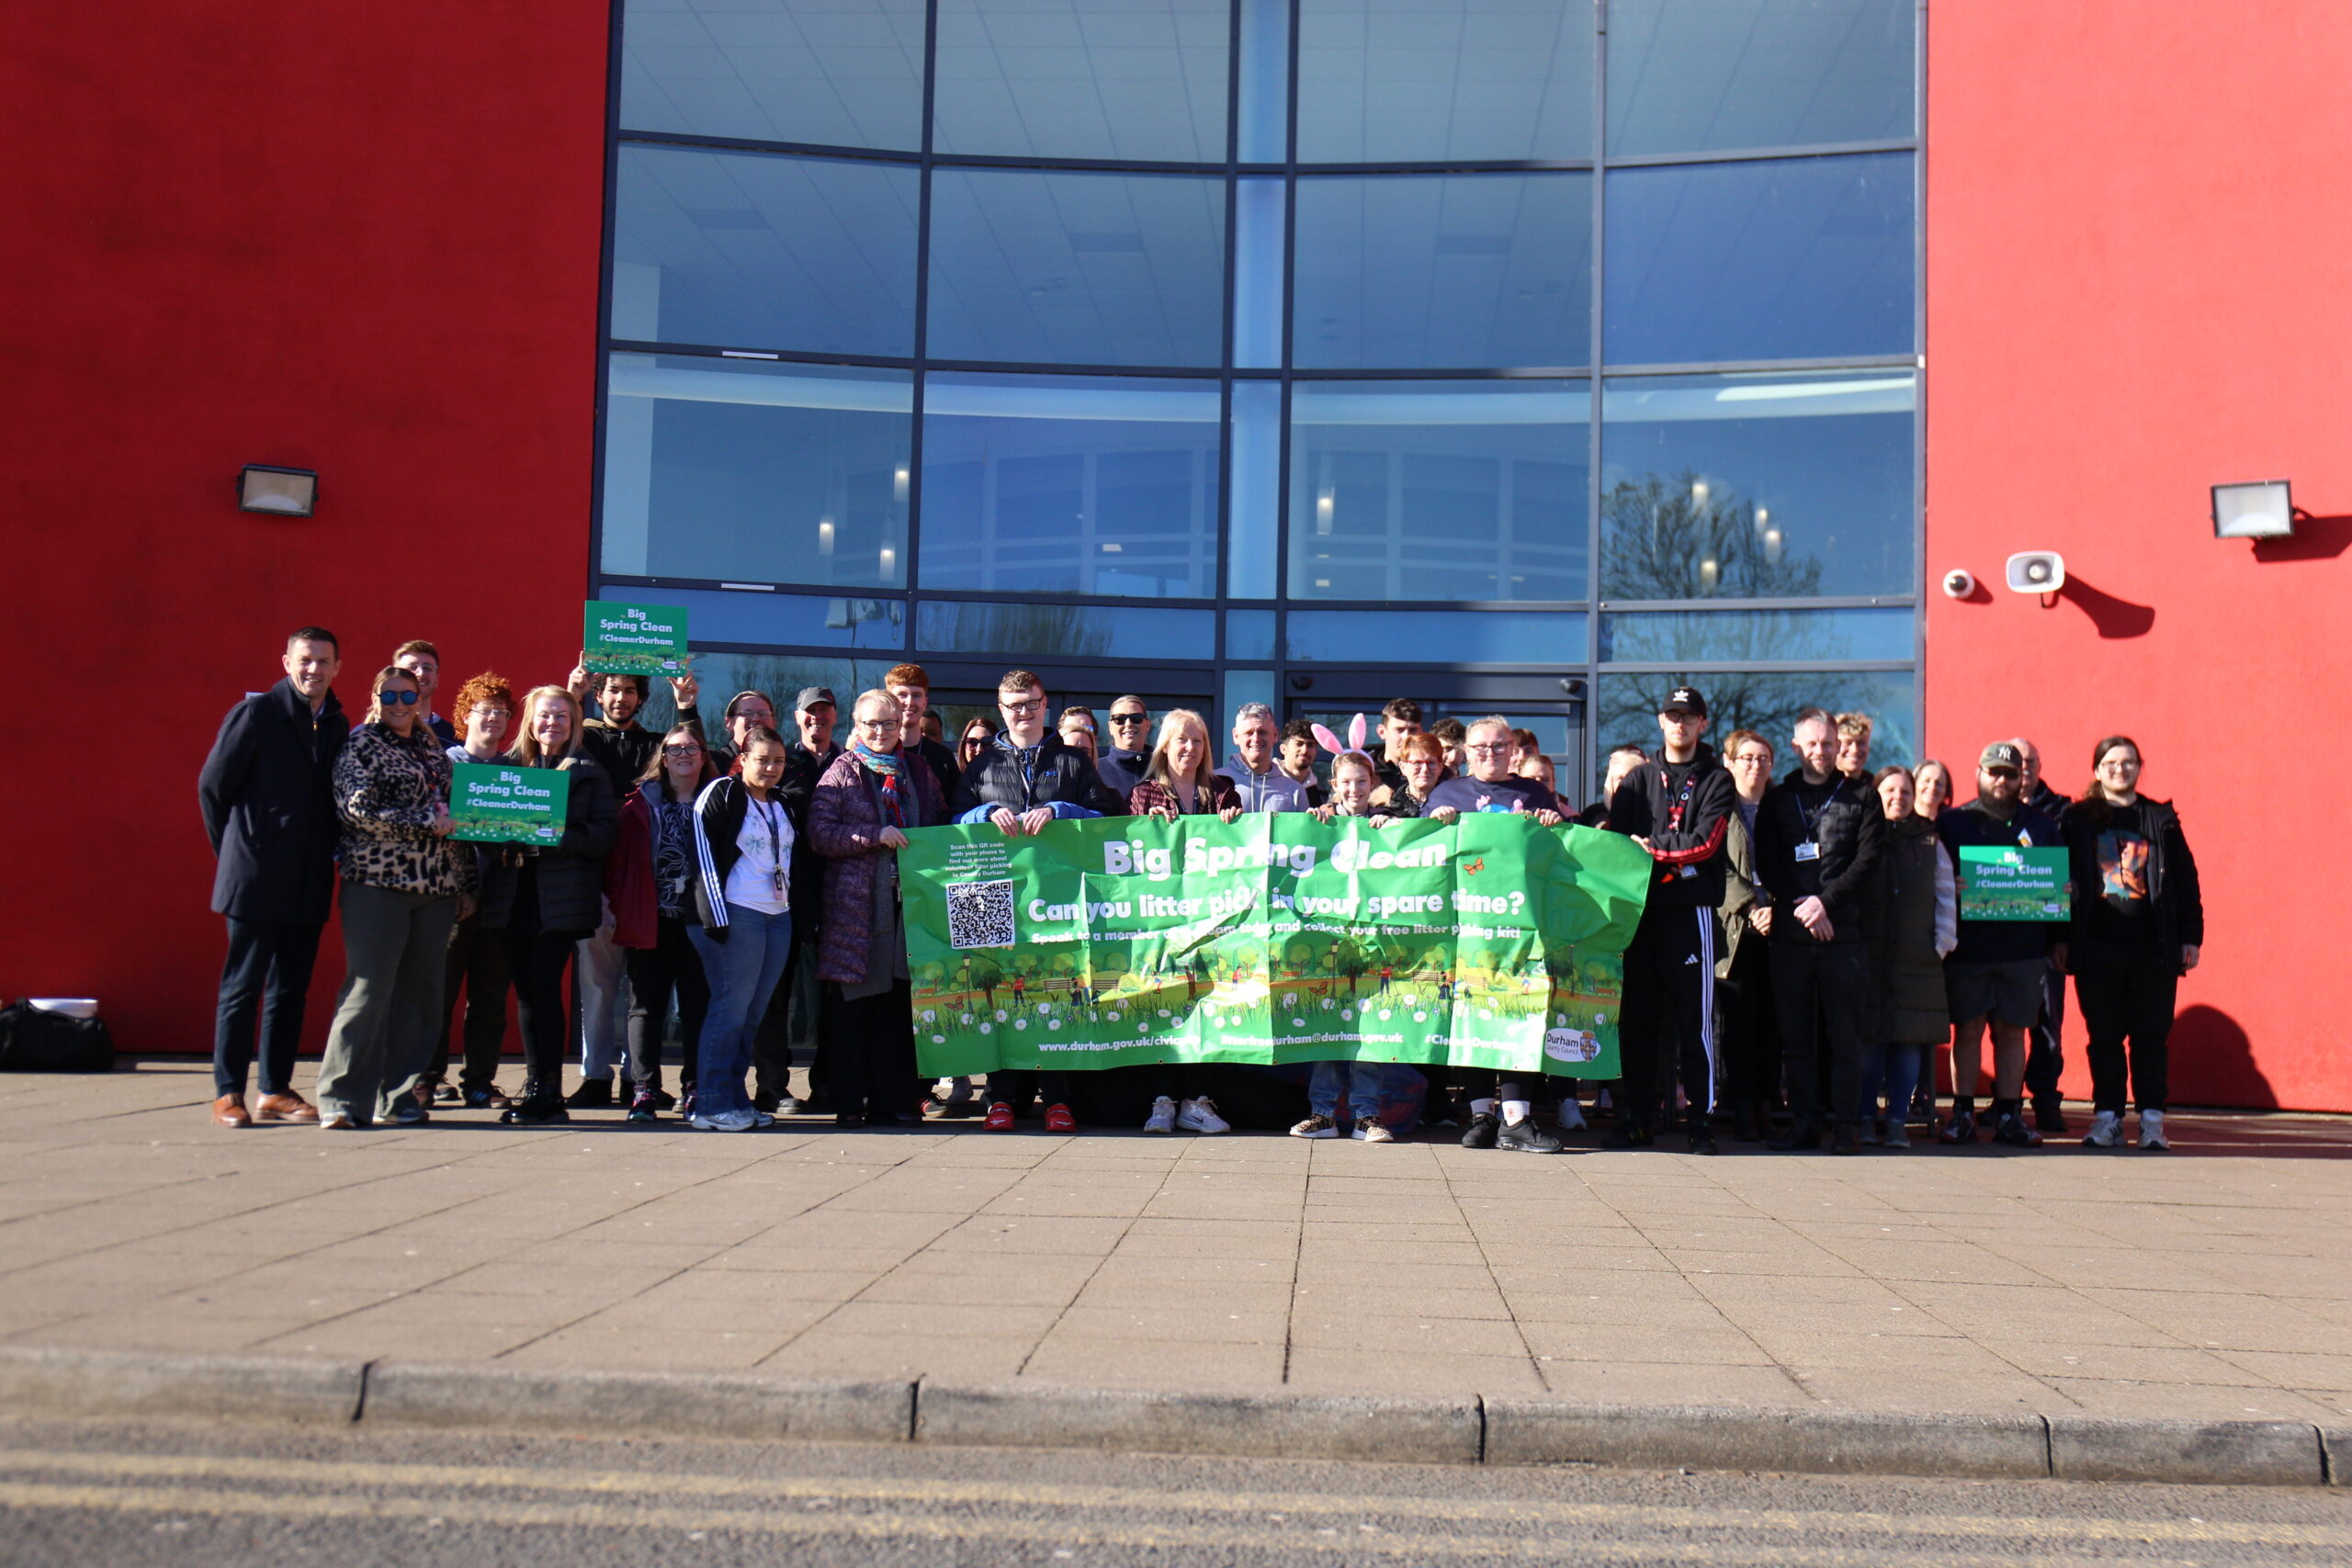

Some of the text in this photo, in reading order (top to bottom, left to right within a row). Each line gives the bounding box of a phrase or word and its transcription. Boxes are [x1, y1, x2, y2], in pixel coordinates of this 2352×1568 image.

[628, 608, 646, 620] Big
[600, 619, 673, 632] Spring Clean
[599, 634, 673, 646] #CleanerDurham
[500, 772, 521, 784] Big
[469, 782, 550, 797] Spring Clean
[466, 798, 550, 811] #CleanerDurham
[1103, 837, 1447, 882] Big Spring Clean
[2004, 852, 2023, 864] Big
[944, 863, 974, 872] volunteer
[1976, 864, 2052, 876] Spring Clean
[1975, 879, 2053, 888] #CleanerDurham
[1028, 886, 1525, 923] Can you litter pick in your spare time?
[1032, 931, 1074, 945] Speak
[1077, 931, 1091, 941] to
[1093, 931, 1102, 942] a
[1105, 929, 1159, 942] member
[1274, 921, 1300, 932] and
[1304, 922, 1346, 935] collect
[1349, 925, 1377, 938] your
[1381, 925, 1409, 935] free
[1413, 924, 1448, 934] litter
[1497, 925, 1521, 938] kit!
[1546, 1032, 1579, 1047] Durham
[1545, 1043, 1578, 1055] County Council
